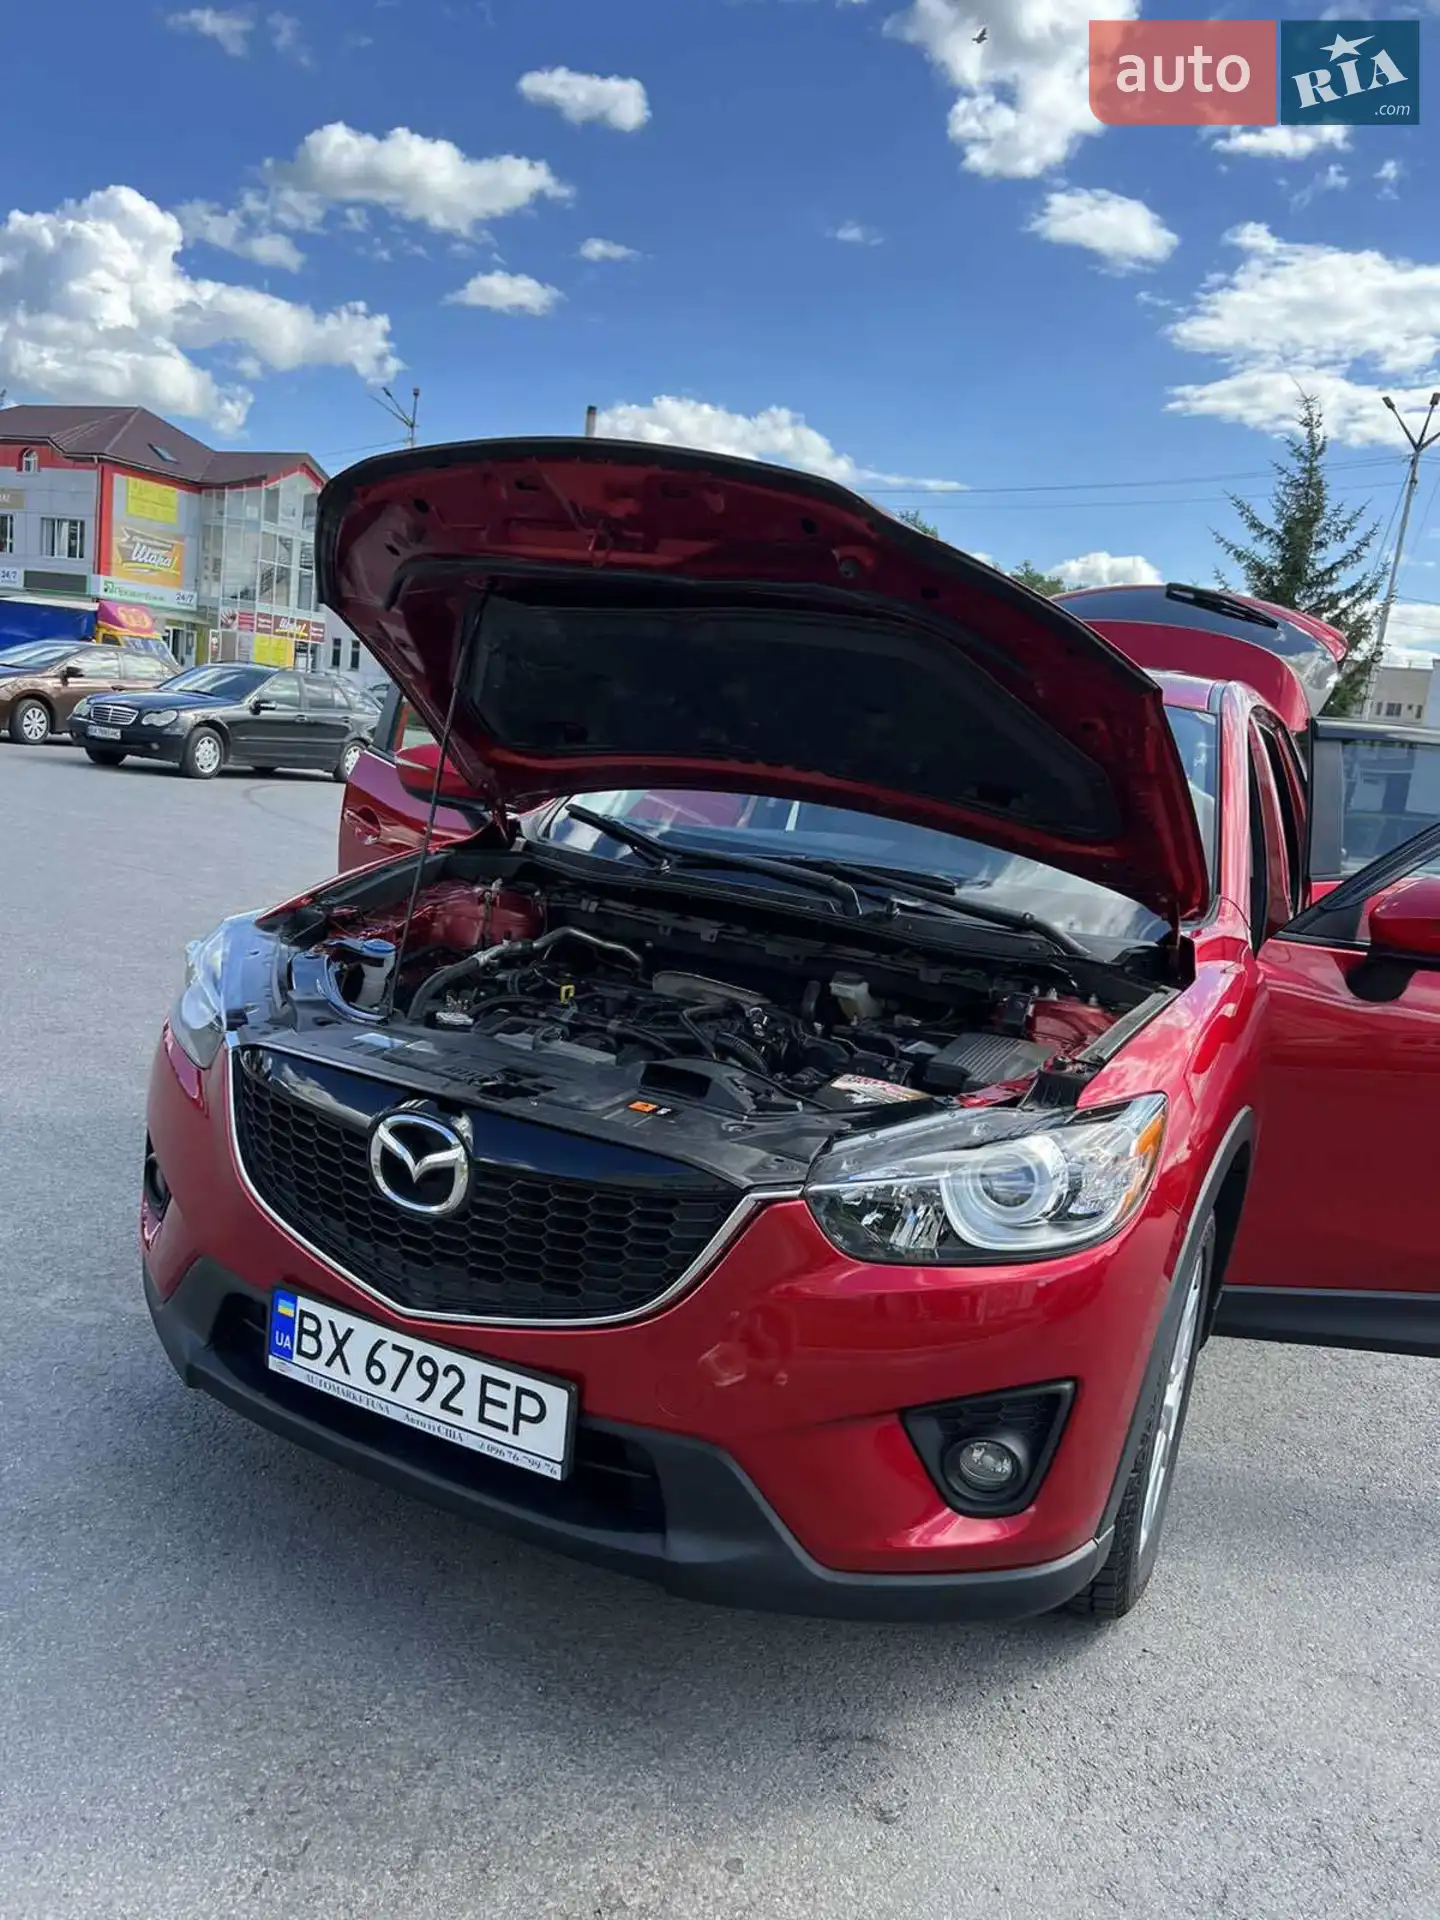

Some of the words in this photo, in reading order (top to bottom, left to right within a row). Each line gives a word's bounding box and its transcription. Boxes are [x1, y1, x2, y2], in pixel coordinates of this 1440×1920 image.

[175, 592, 195, 603] 24/7
[275, 1330, 292, 1348] UA
[296, 1308, 355, 1376] BX
[365, 1338, 466, 1417] 6792
[477, 1373, 547, 1436] EP
